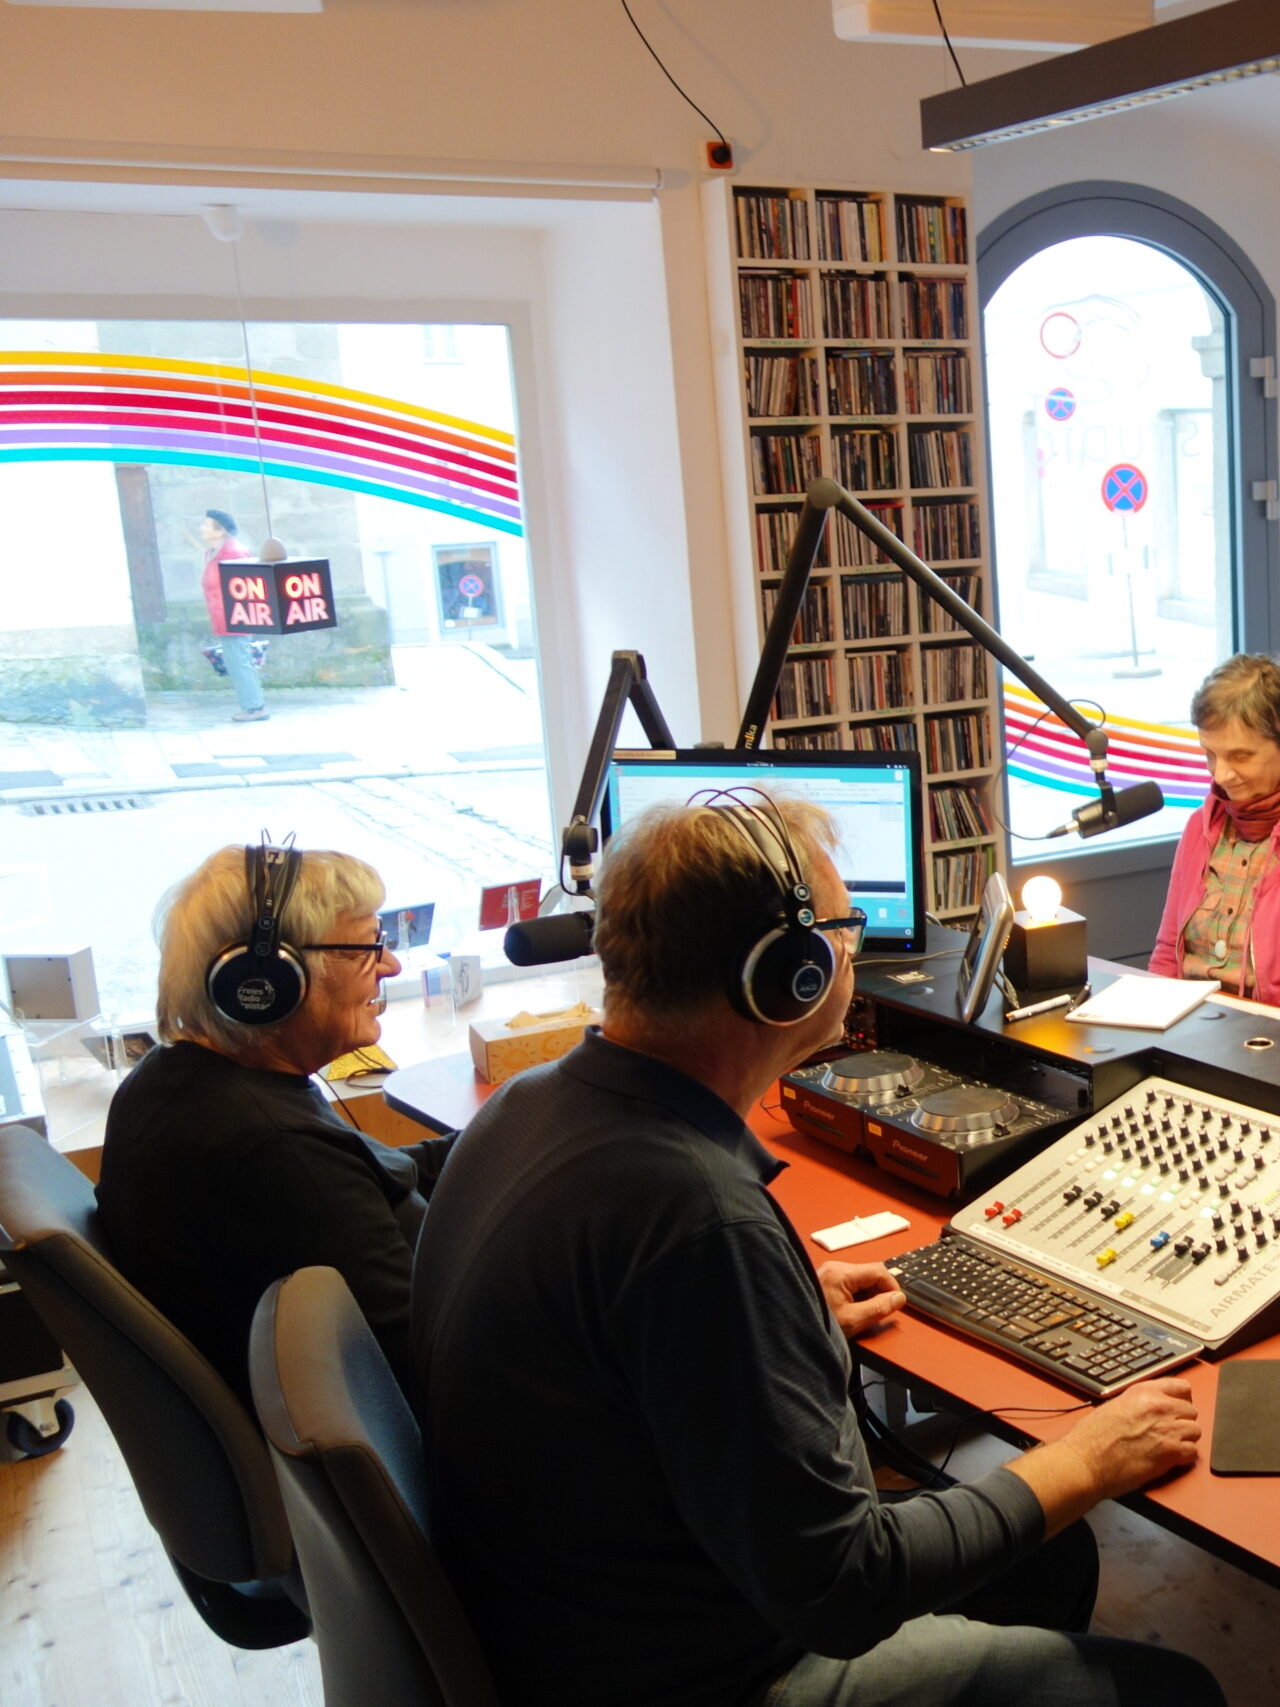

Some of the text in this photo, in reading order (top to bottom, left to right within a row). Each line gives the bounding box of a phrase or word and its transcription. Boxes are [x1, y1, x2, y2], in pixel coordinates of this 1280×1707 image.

[228, 576, 267, 600] ON
[285, 572, 322, 598] ON
[230, 602, 275, 626] AIR
[286, 597, 329, 625] AIR
[803, 1100, 835, 1121] Pioneer
[892, 1139, 929, 1162] Pioneer
[1210, 1262, 1277, 1318] AIRMATE
